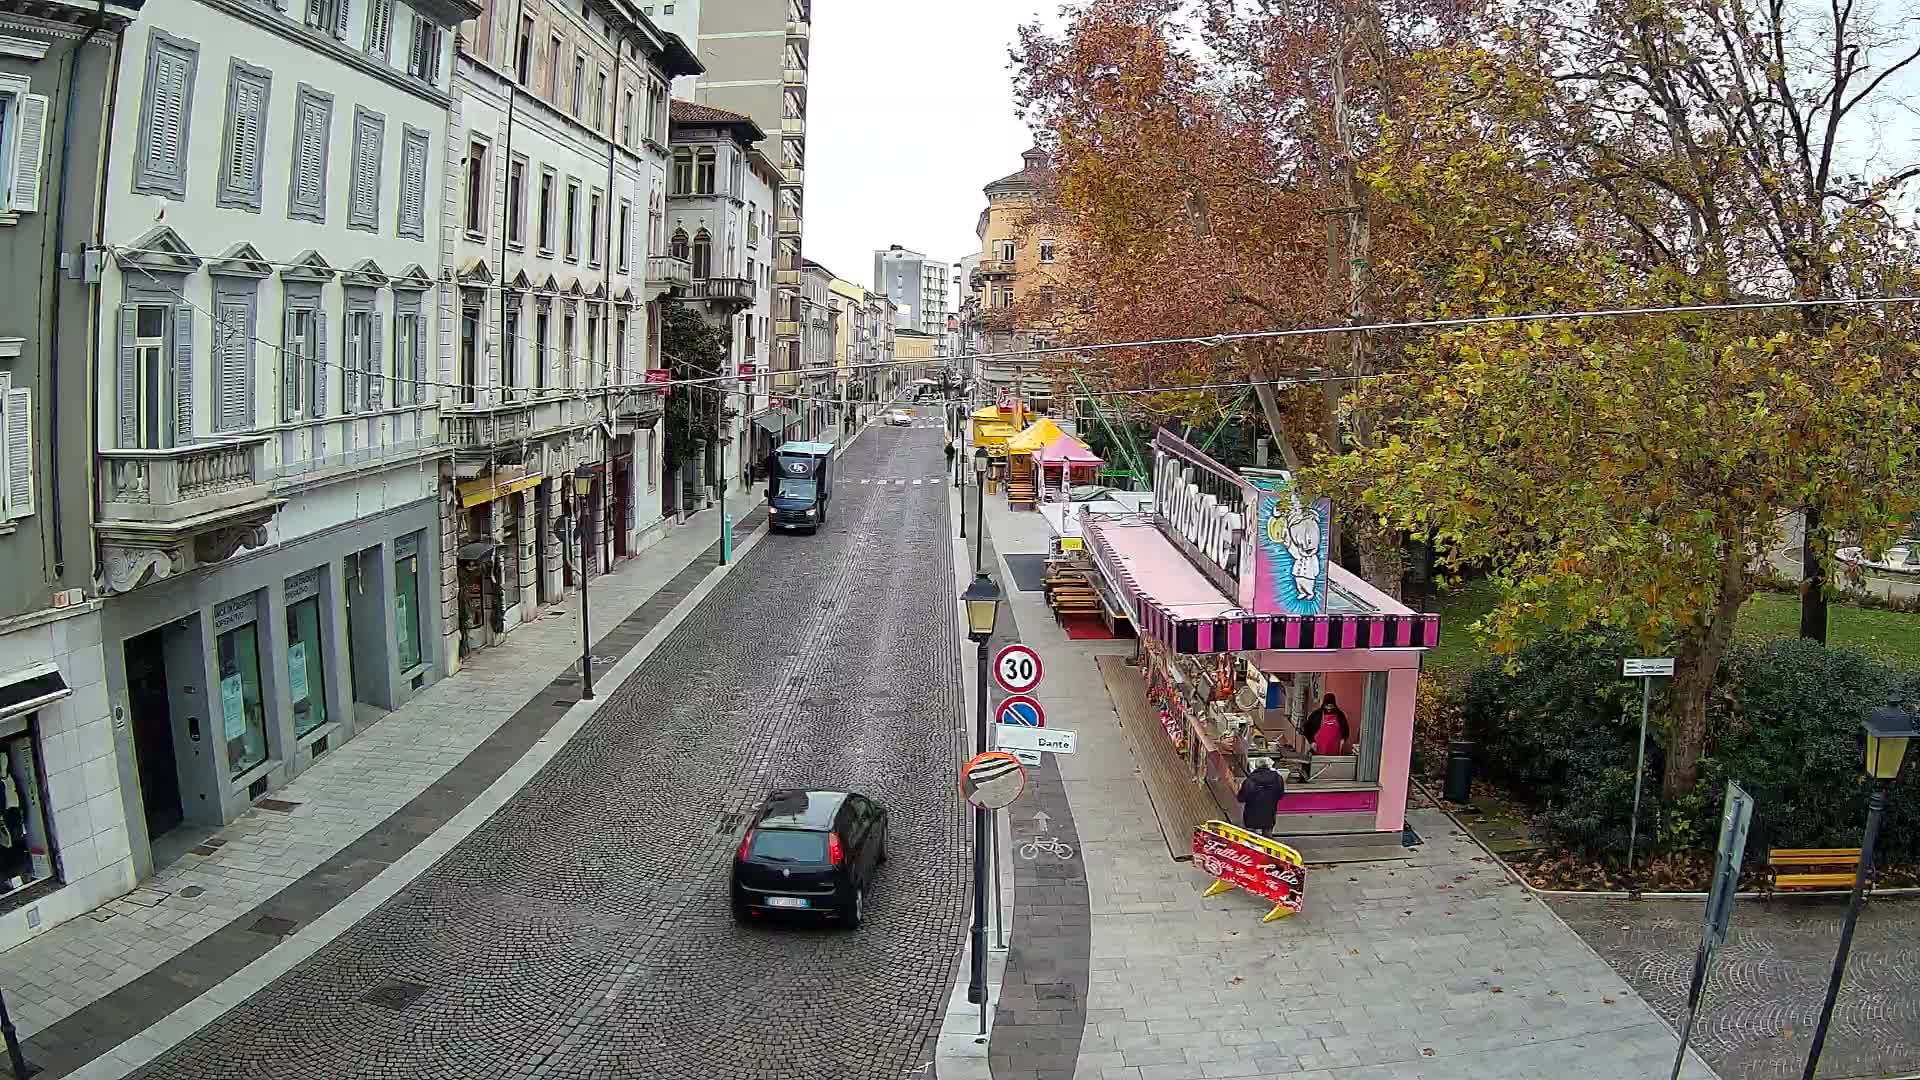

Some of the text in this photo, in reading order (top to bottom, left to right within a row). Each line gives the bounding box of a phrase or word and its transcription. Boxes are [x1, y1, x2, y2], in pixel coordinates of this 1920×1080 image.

[1005, 658, 1033, 680] 30
[1038, 737, 1070, 749] Dante
[1256, 863, 1298, 885] Calde
